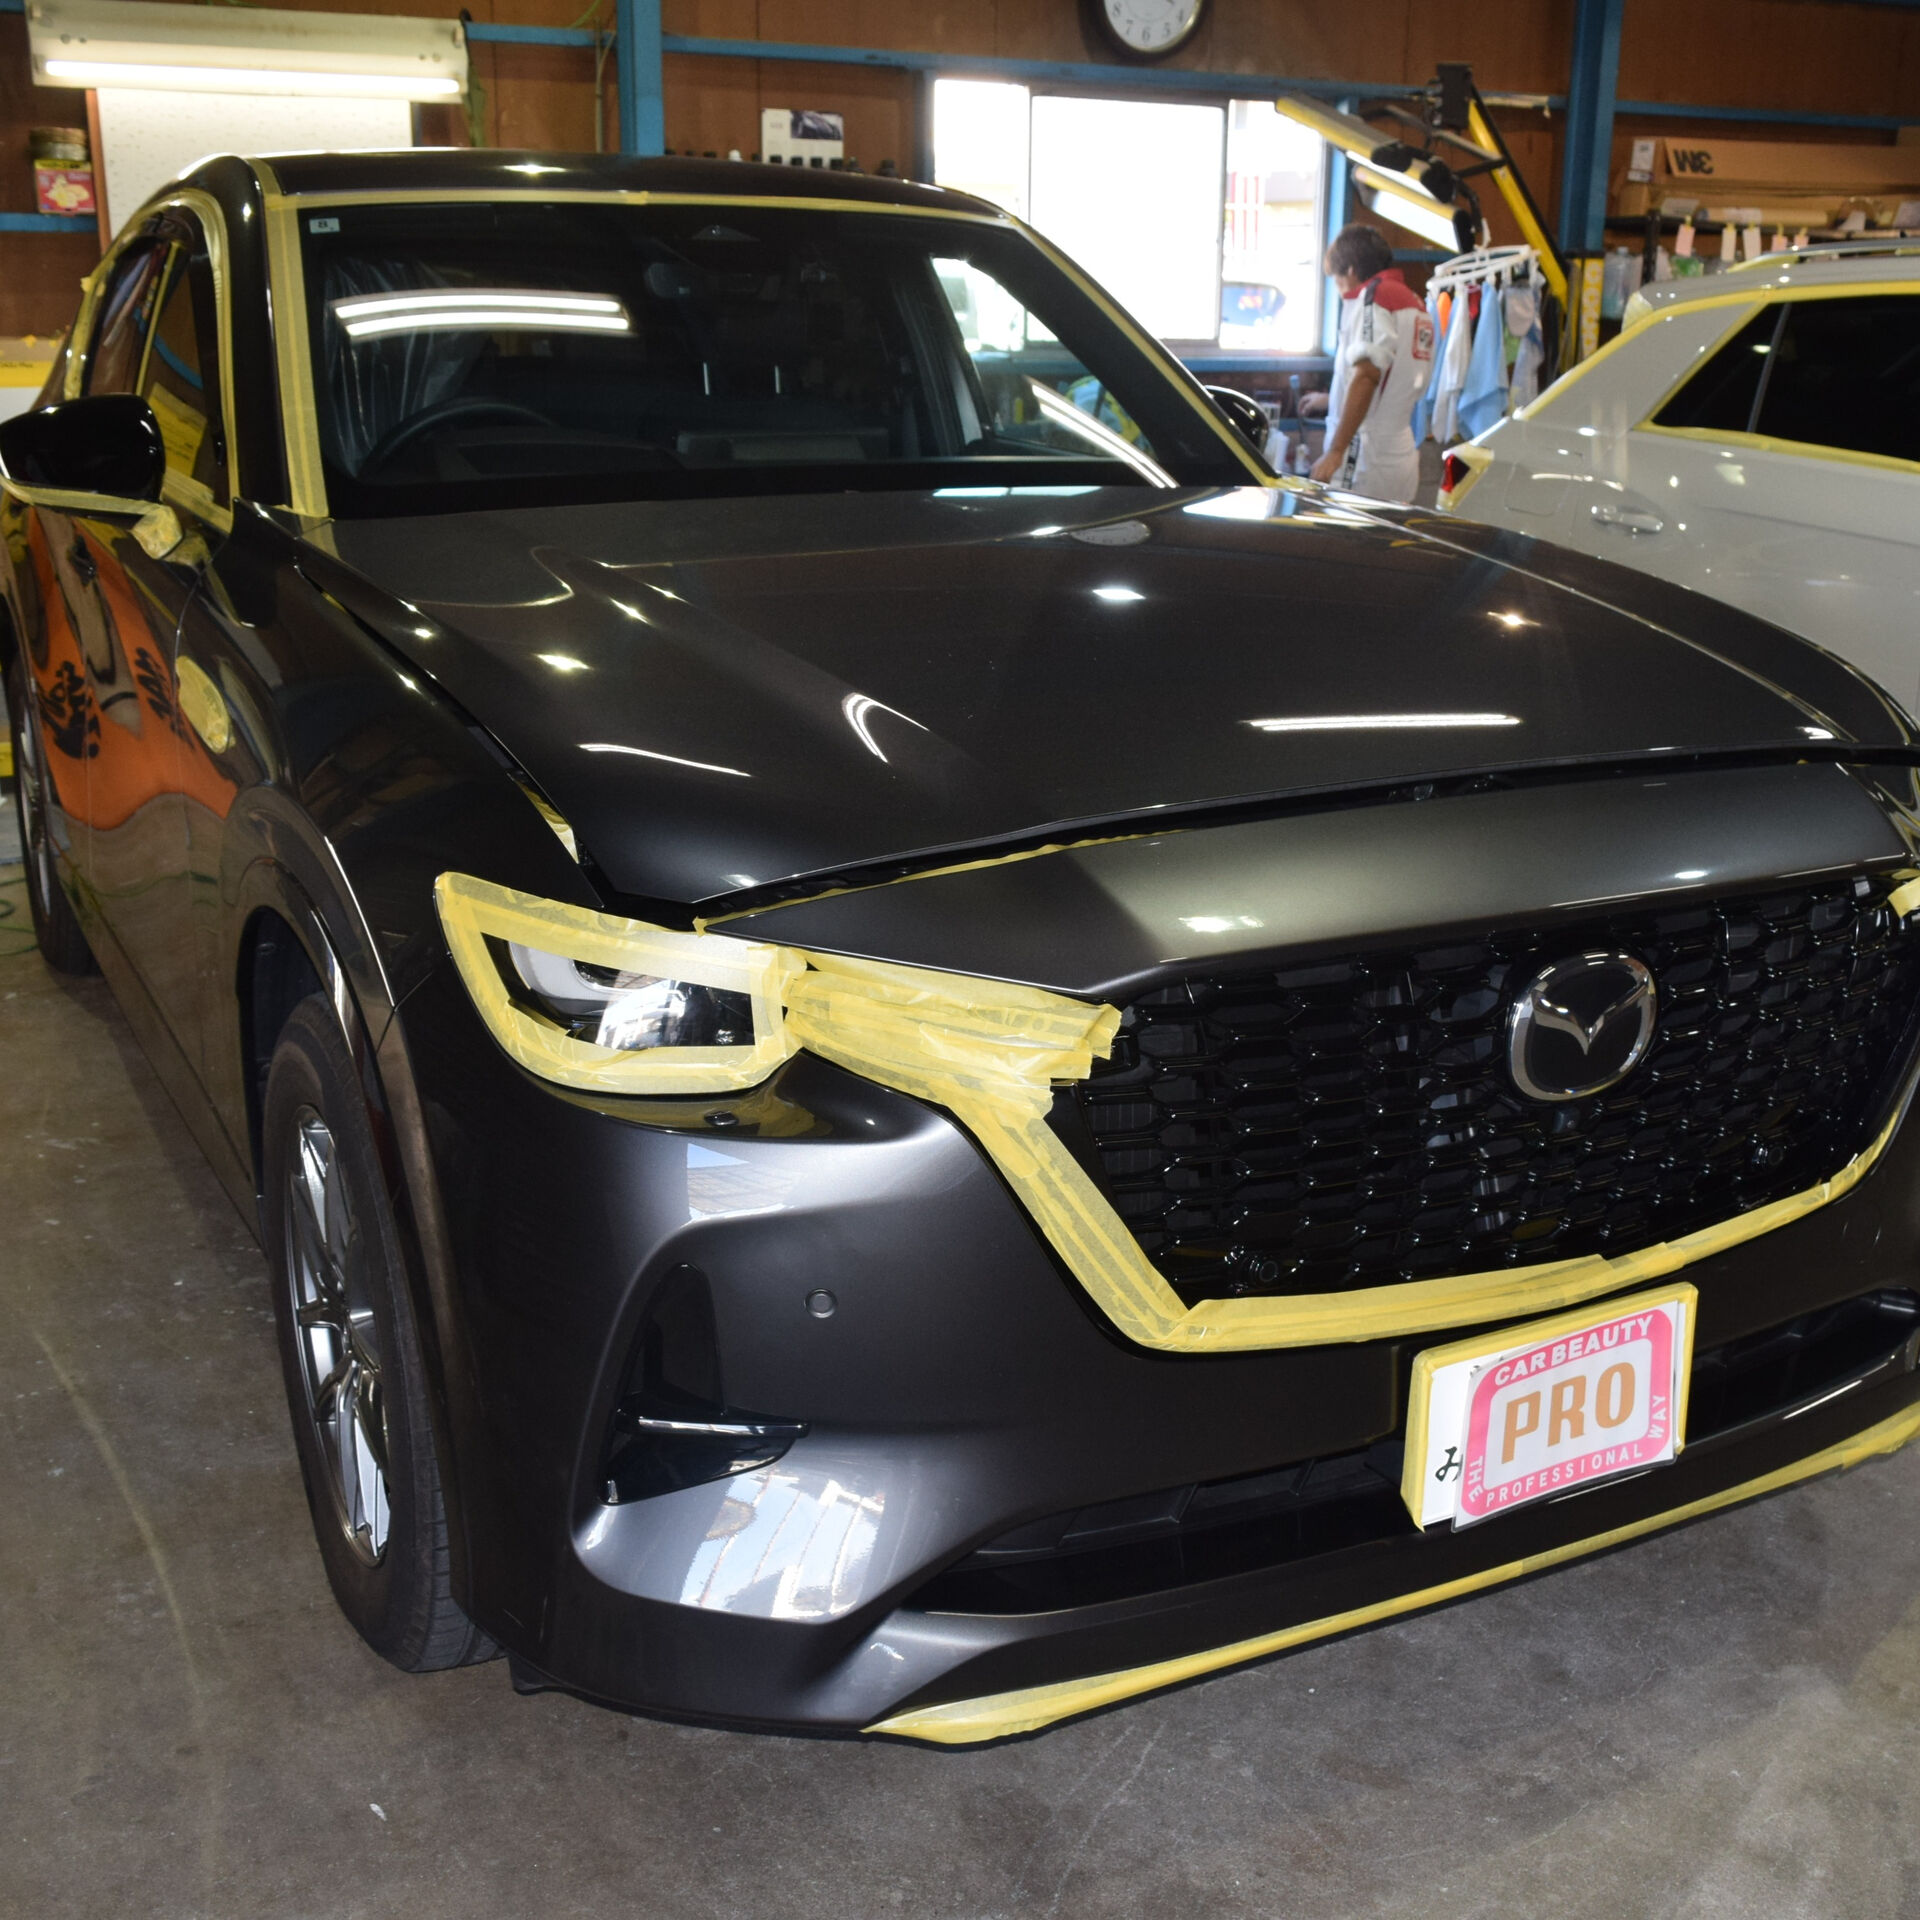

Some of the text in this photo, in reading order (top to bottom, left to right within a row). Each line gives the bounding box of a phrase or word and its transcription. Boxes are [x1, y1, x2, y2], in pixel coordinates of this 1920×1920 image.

[1142, 26, 1151, 42] 6
[1495, 1352, 1546, 1386] CAR
[1551, 1314, 1654, 1367] BEAUTY
[1501, 1361, 1636, 1465] PRO
[1648, 1395, 1667, 1439] WAY
[1468, 1456, 1484, 1503] THE
[1486, 1444, 1643, 1508] PROFESSIONAL
